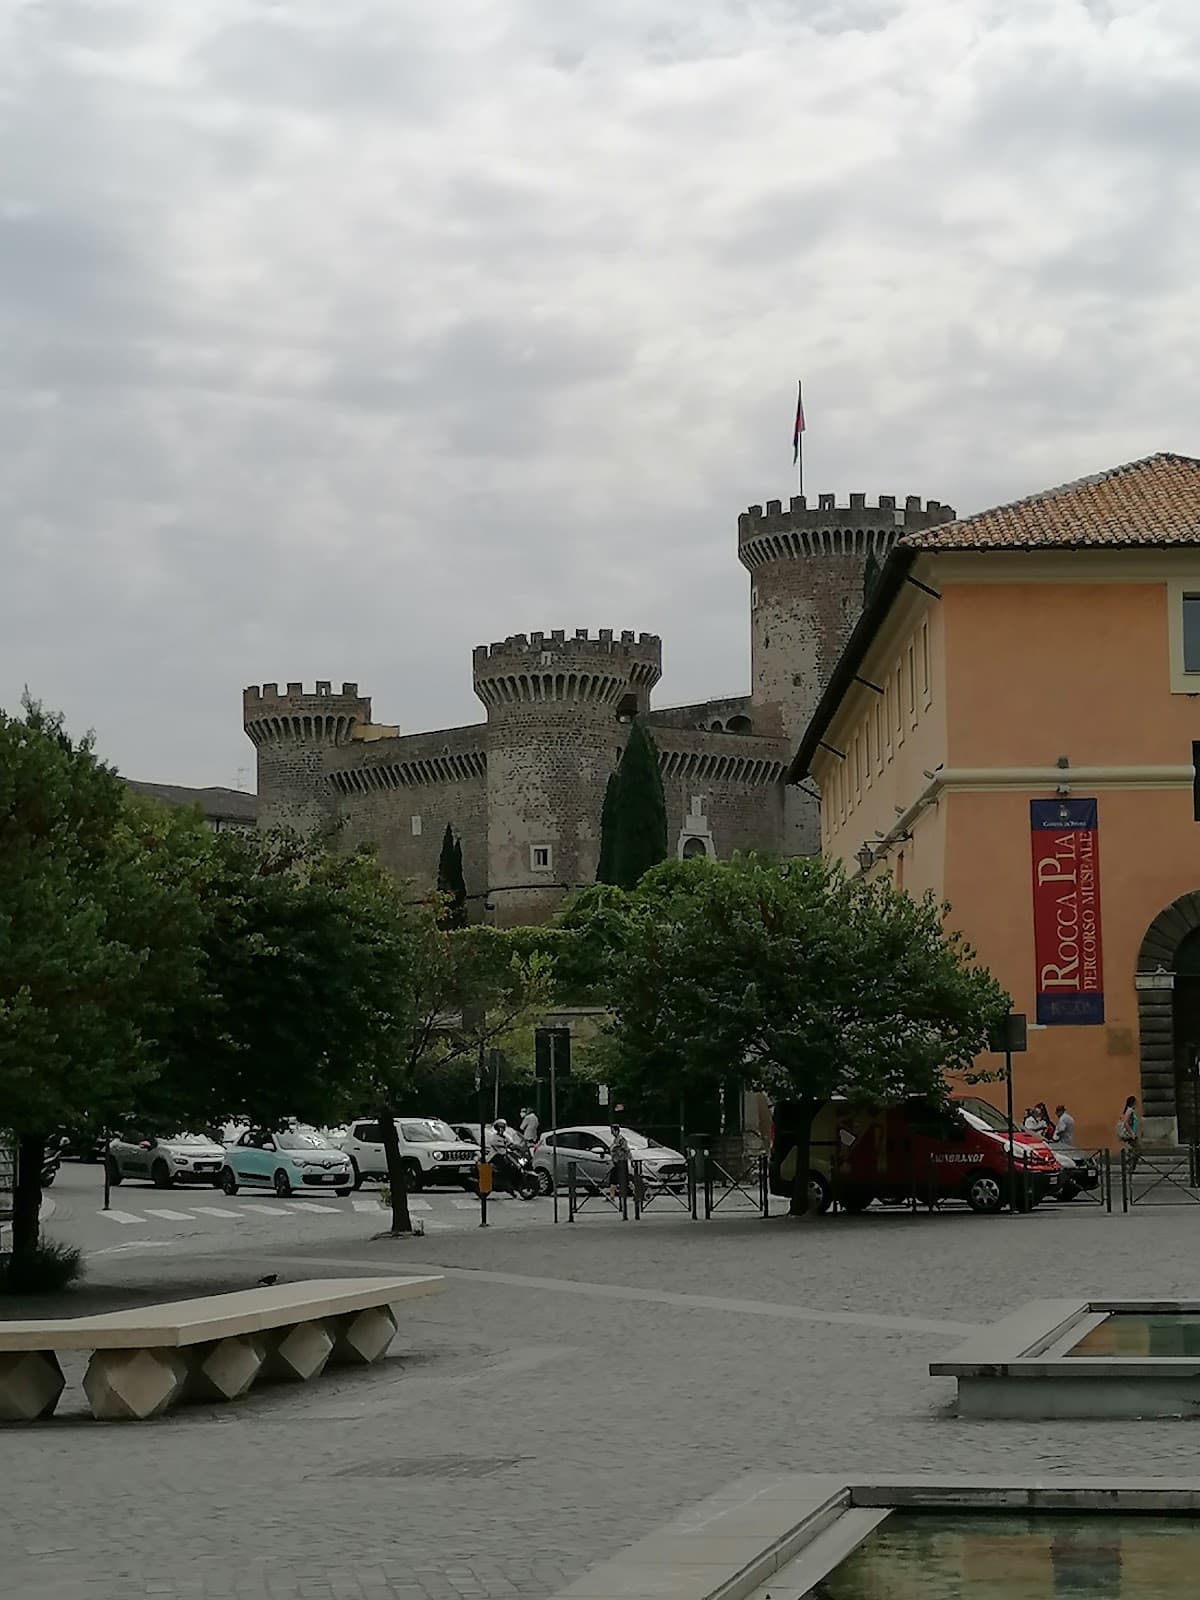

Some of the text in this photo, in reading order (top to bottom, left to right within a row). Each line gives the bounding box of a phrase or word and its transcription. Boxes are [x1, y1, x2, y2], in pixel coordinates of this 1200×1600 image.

[1037, 832, 1077, 886] PIA
[1041, 891, 1080, 991] ROCCA
[1080, 831, 1097, 990] PERCORSO MUSEALE
